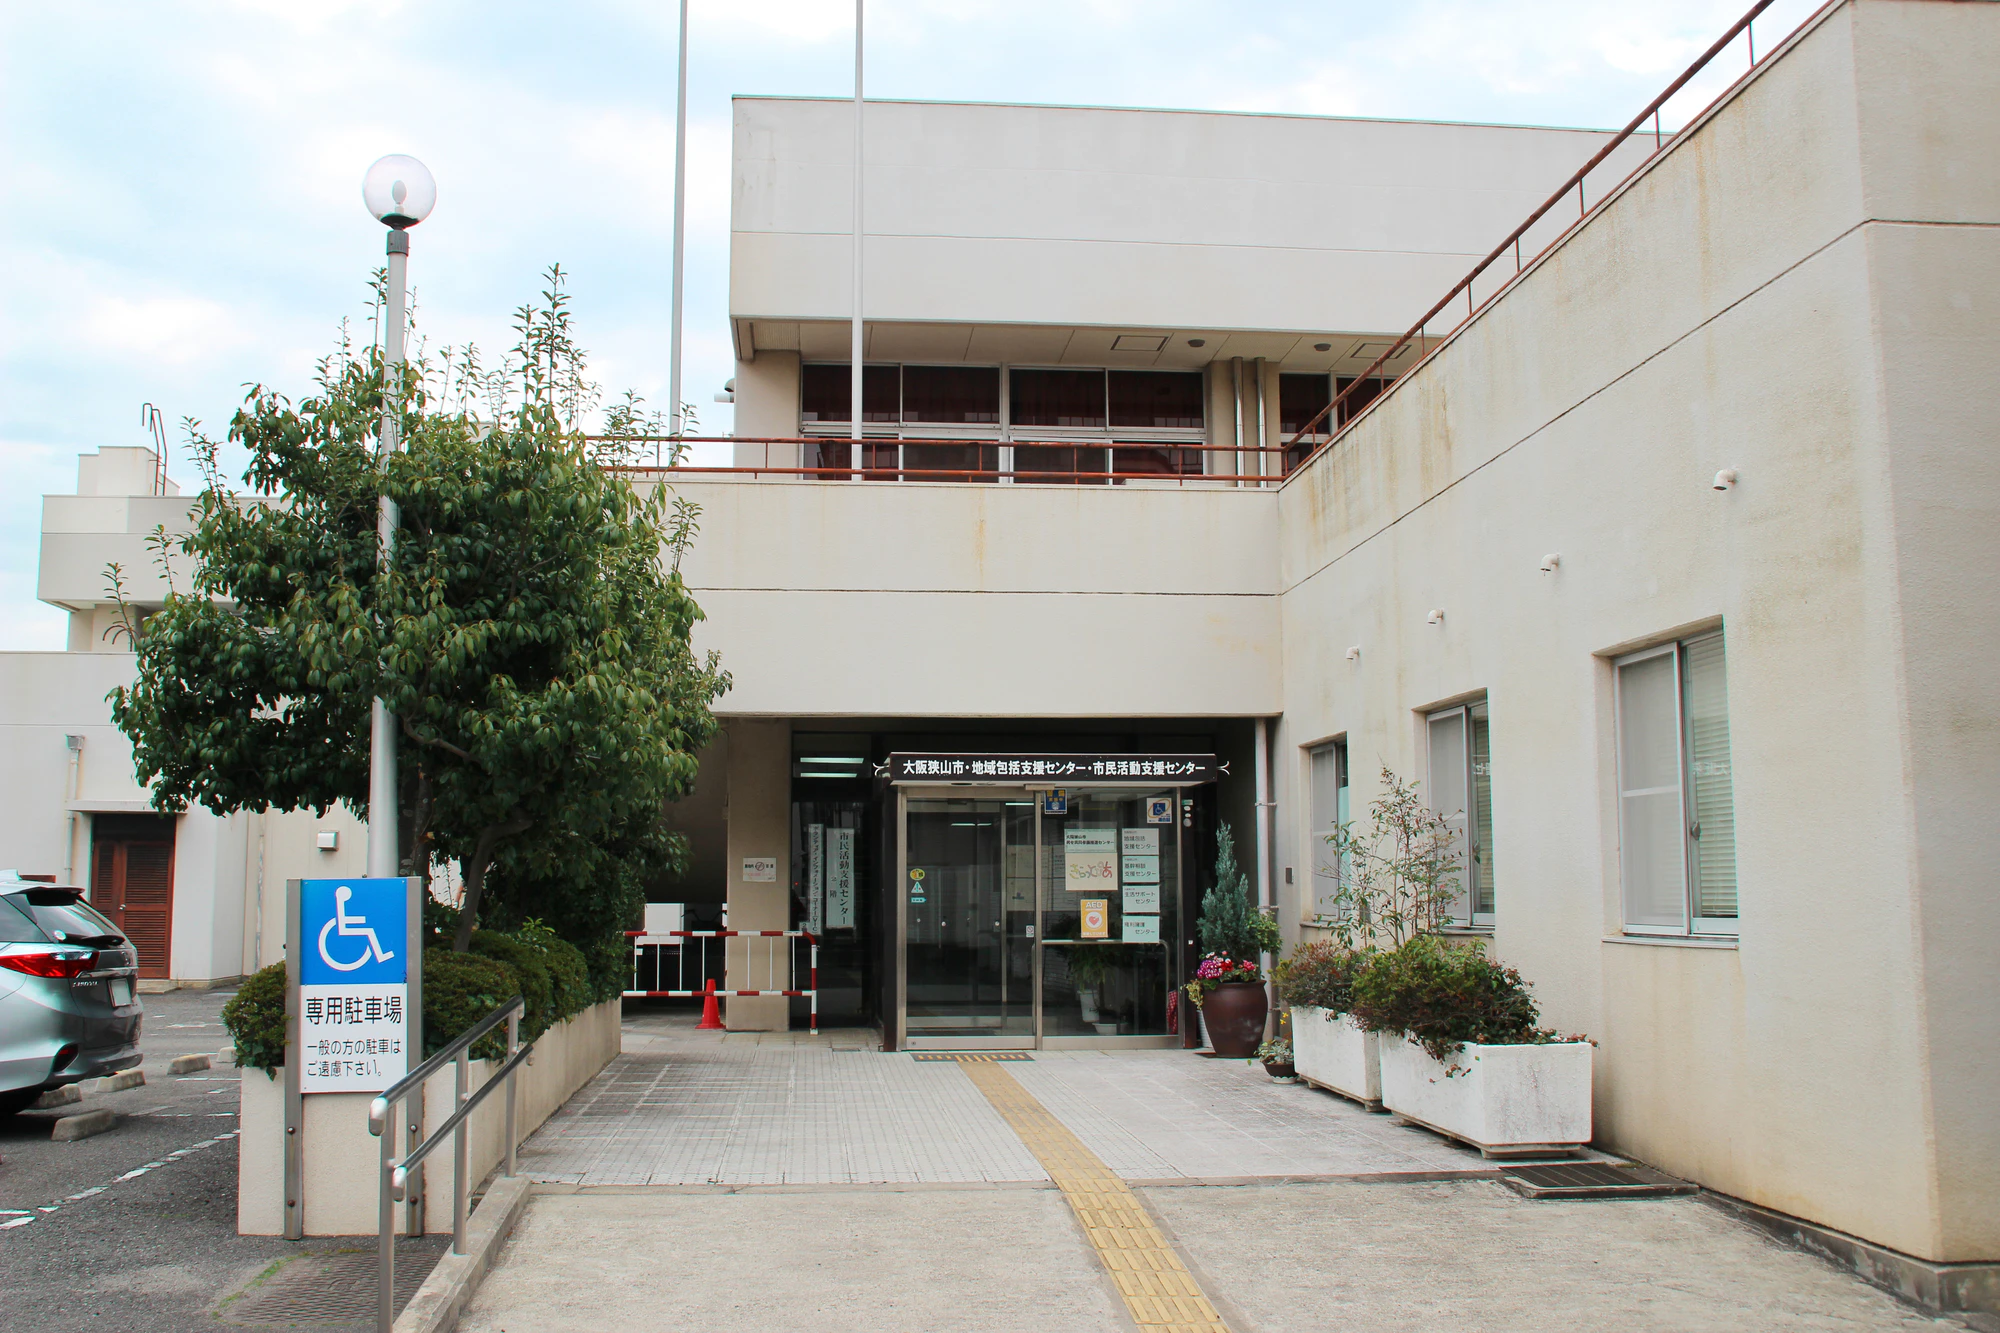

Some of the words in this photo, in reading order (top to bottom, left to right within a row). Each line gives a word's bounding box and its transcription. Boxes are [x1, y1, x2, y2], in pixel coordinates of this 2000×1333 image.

[839, 832, 849, 925] 市民活動支援センター
[305, 996, 403, 1025] 専用駐車場
[307, 1038, 402, 1056] 一般の方の駐車は
[307, 1059, 383, 1078] ご遠慮下さい。
